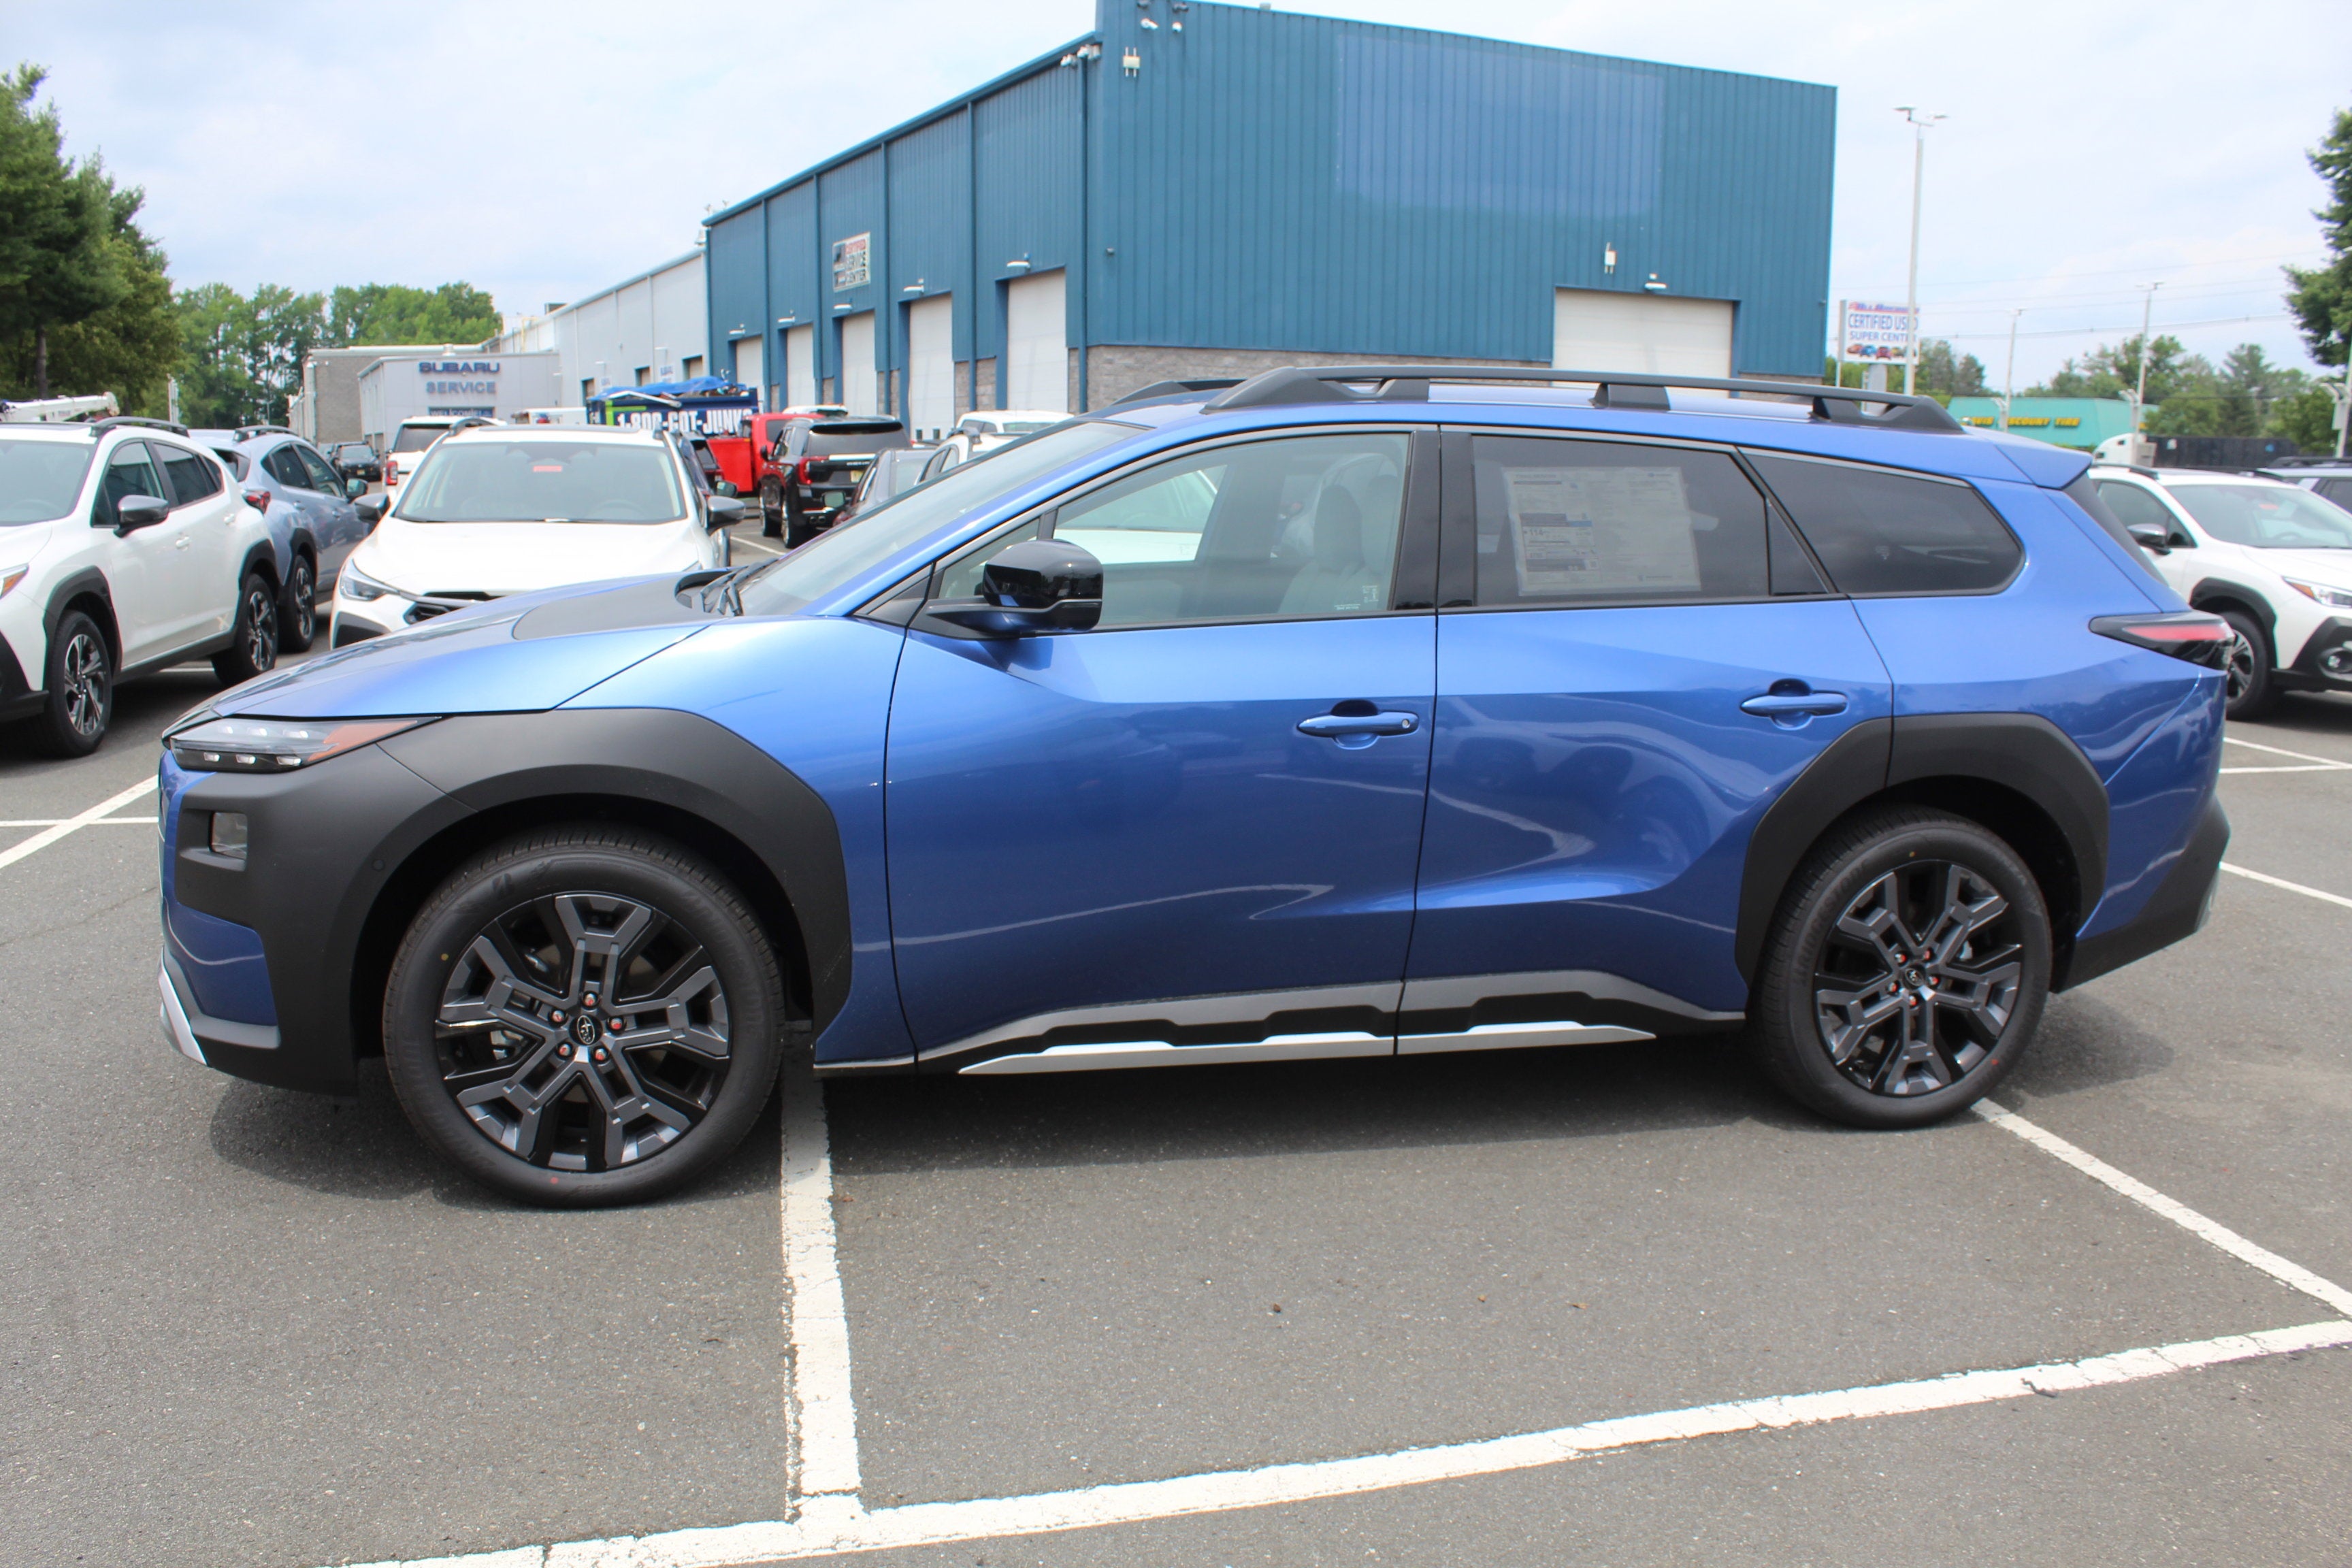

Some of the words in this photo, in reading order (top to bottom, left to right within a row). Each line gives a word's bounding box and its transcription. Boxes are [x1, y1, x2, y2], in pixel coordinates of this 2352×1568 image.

[1848, 313, 1893, 330] CERTIFIED
[1895, 315, 1918, 331] USD
[1850, 331, 1880, 341] SUPER
[419, 361, 501, 373] SUBARU
[426, 381, 496, 393] SERVICE
[2055, 417, 2081, 427] TIRE
